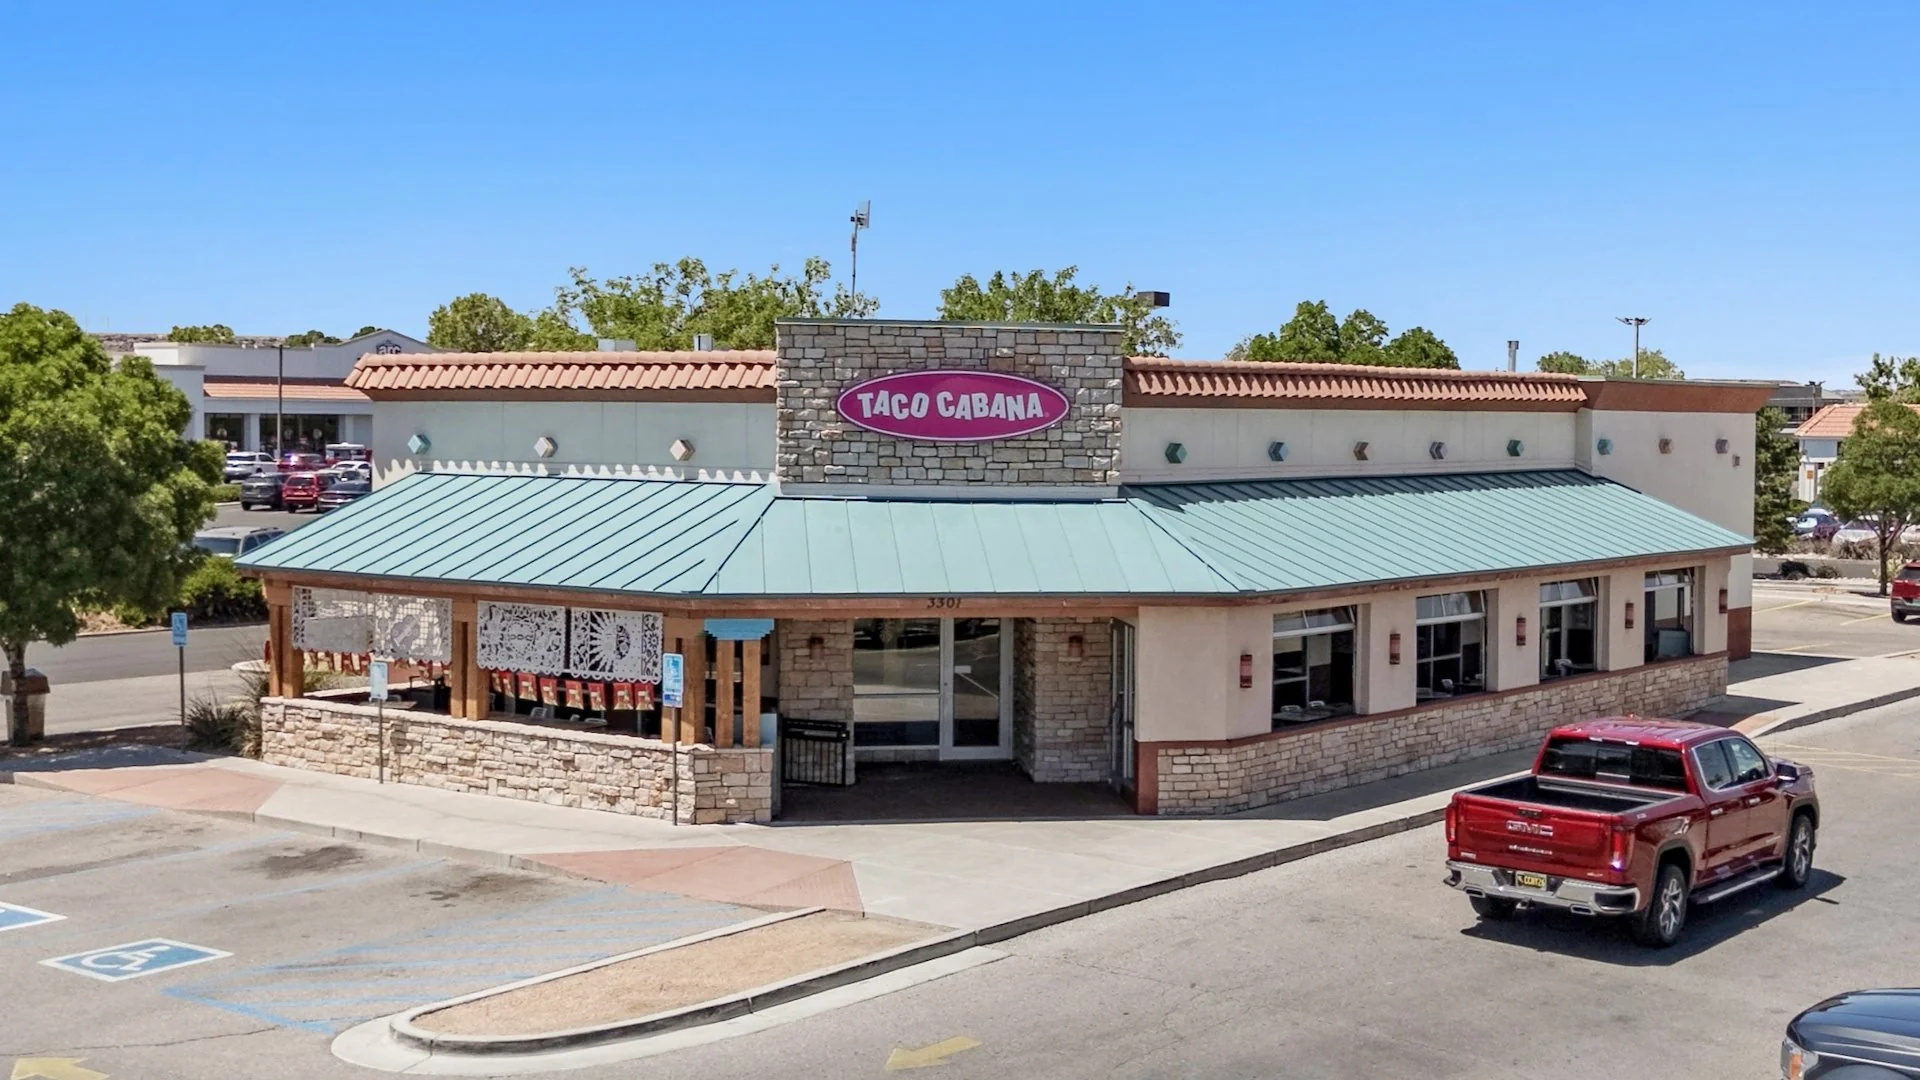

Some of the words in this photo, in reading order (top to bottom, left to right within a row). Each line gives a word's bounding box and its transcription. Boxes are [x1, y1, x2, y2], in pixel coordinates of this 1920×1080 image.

[857, 390, 930, 420] TACO
[936, 391, 1044, 421] CABANA
[927, 597, 961, 609] 3301
